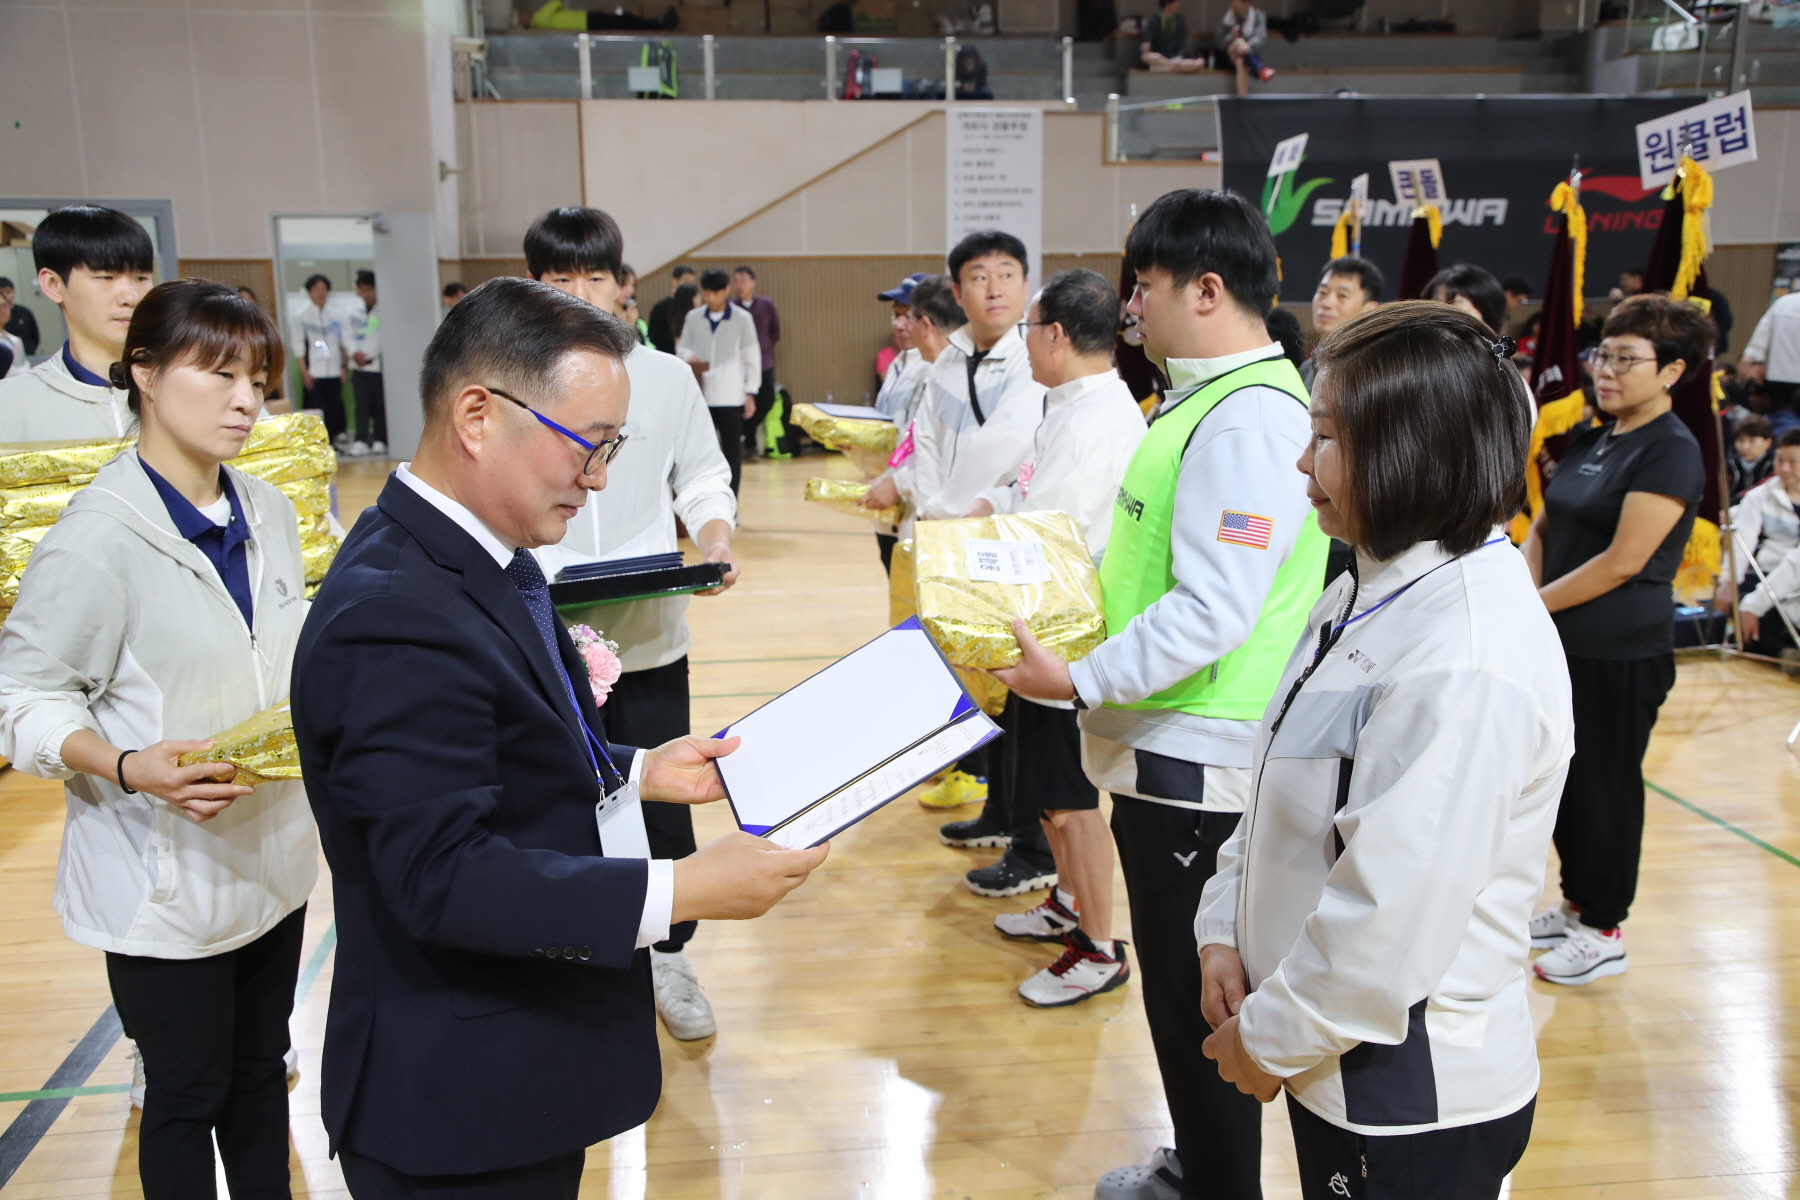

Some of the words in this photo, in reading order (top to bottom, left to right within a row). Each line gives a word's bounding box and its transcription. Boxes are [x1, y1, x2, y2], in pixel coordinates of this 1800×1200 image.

[1644, 105, 1749, 174] 원클럽
[1311, 198, 1509, 226] SAMWA
[1542, 208, 1666, 234] LNING
